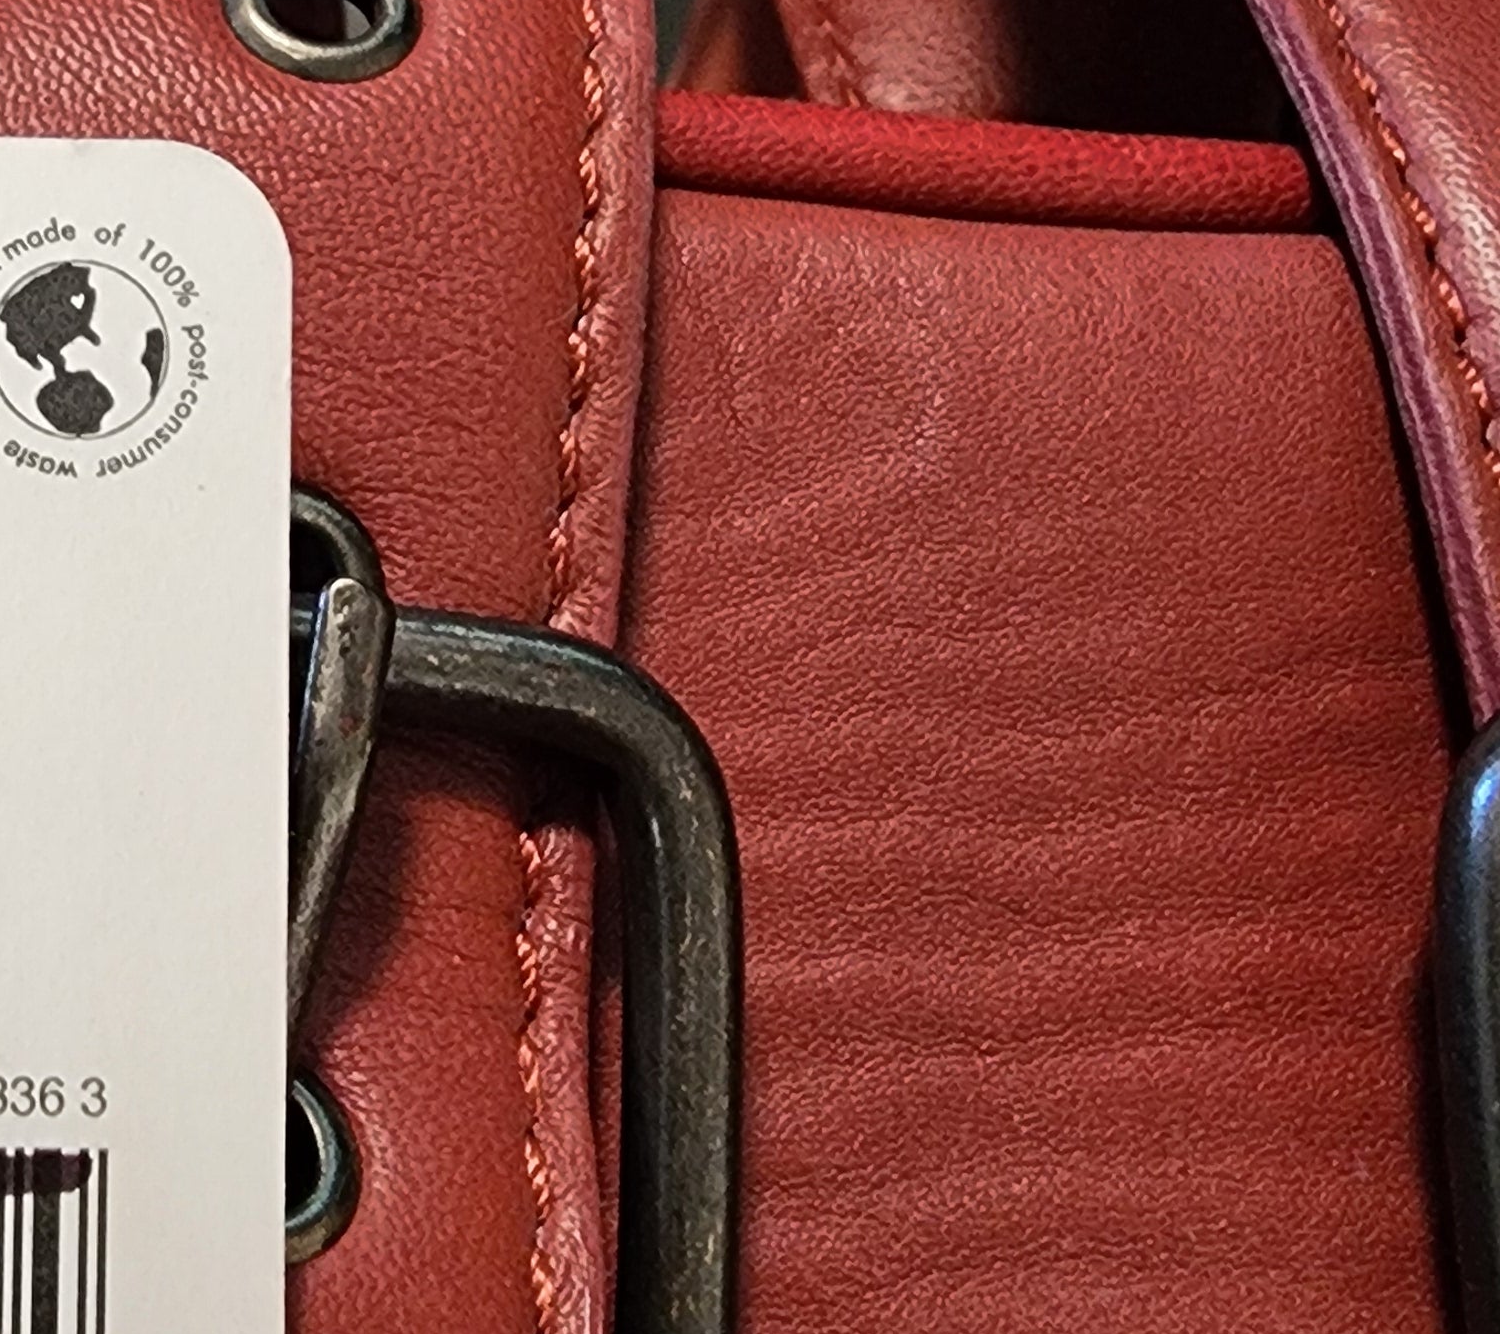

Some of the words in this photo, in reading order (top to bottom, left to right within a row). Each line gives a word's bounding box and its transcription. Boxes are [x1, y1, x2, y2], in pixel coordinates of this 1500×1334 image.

[1, 216, 77, 261] made
[93, 222, 127, 248] of
[138, 237, 200, 308] 100%
[95, 323, 210, 479] post-consumer
[3, 438, 78, 479] waste
[80, 1076, 108, 1119] 3
